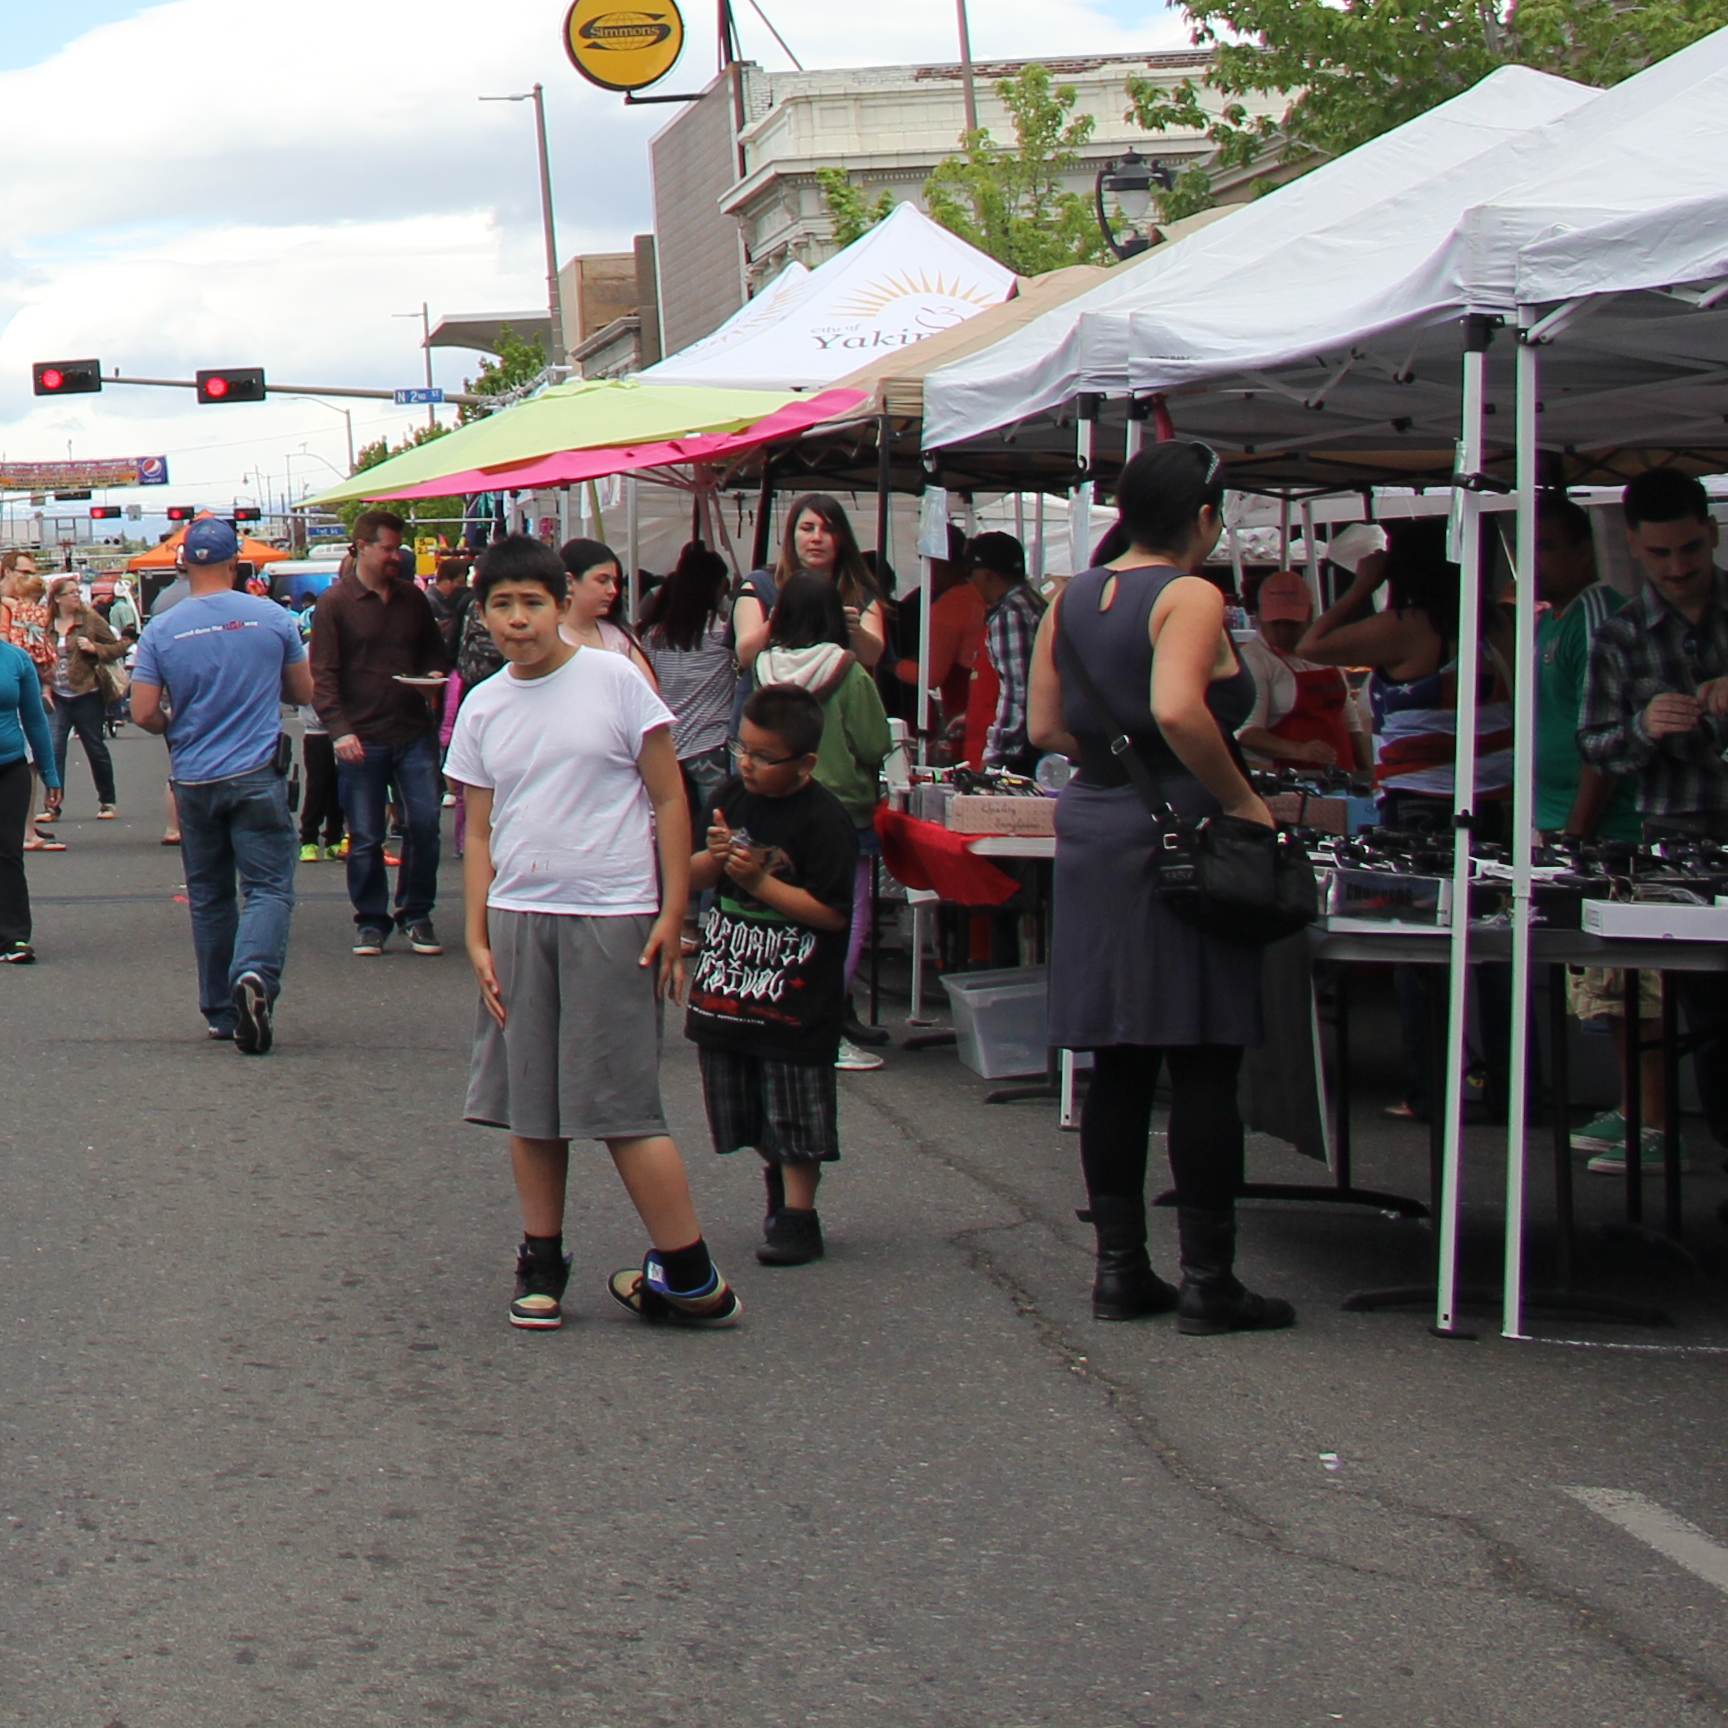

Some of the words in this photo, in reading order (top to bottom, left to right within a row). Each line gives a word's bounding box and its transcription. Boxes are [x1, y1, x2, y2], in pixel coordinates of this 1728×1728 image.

[589, 25, 660, 38] Simmons
[811, 327, 934, 351] Yaki
[397, 391, 406, 403] N
